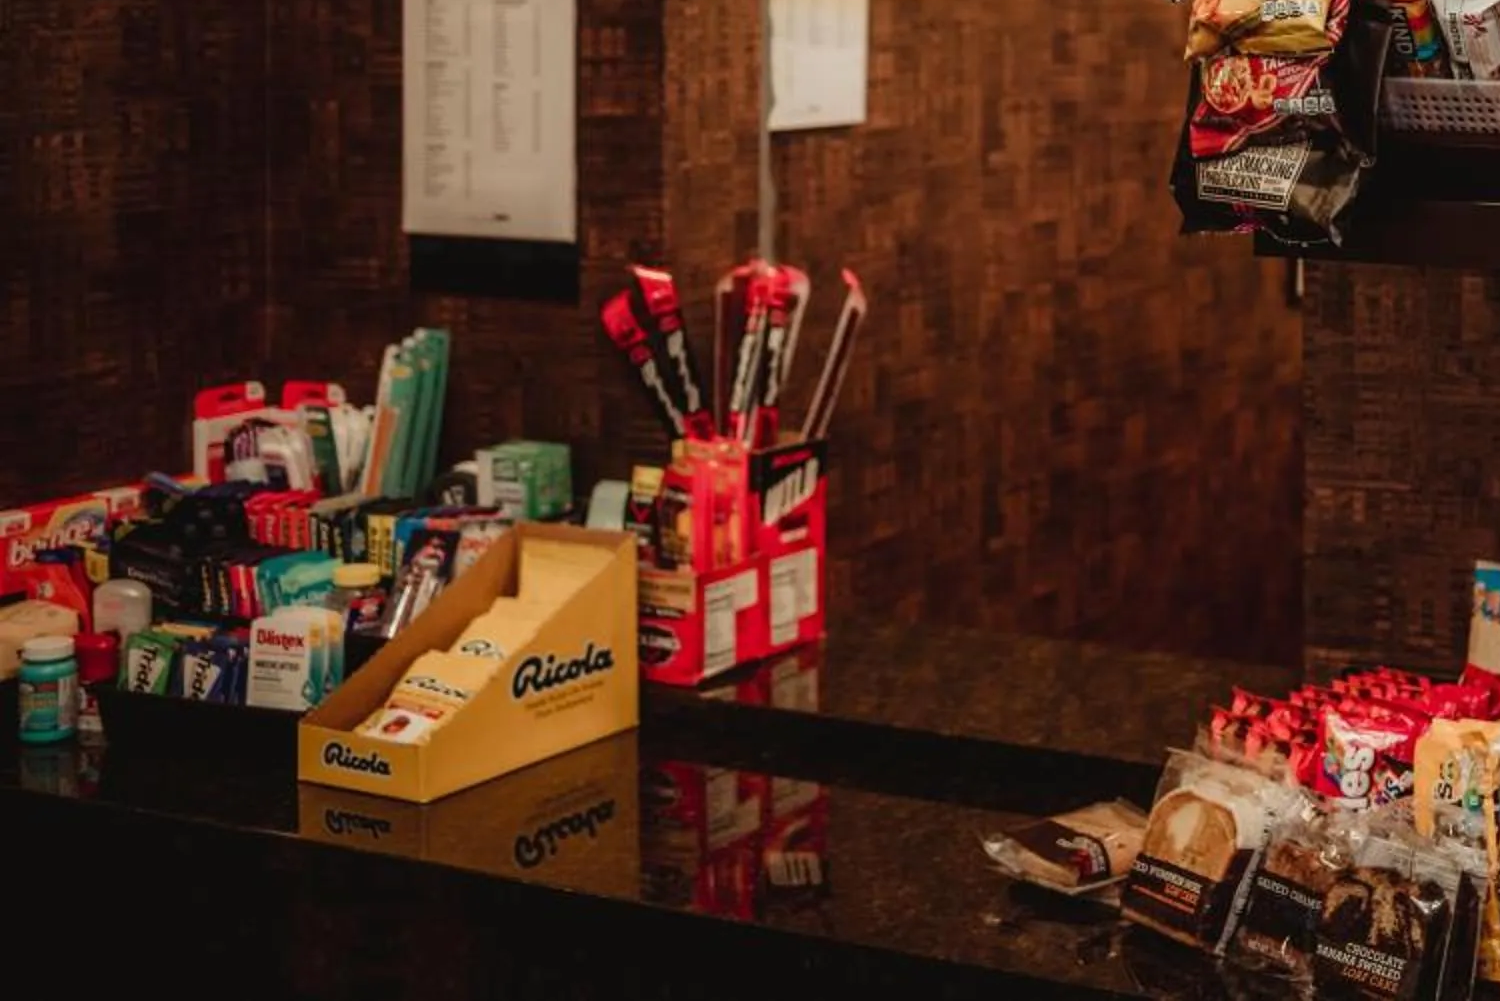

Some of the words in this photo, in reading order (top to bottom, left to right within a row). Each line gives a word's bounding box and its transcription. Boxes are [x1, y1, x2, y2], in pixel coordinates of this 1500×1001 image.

[1388, 9, 1413, 55] KIND
[256, 629, 305, 651] Blistex
[513, 642, 616, 700] Ricola
[323, 742, 392, 777] Ricola
[1315, 943, 1356, 965] BANANA
[1344, 941, 1408, 971] CHOCOLATE
